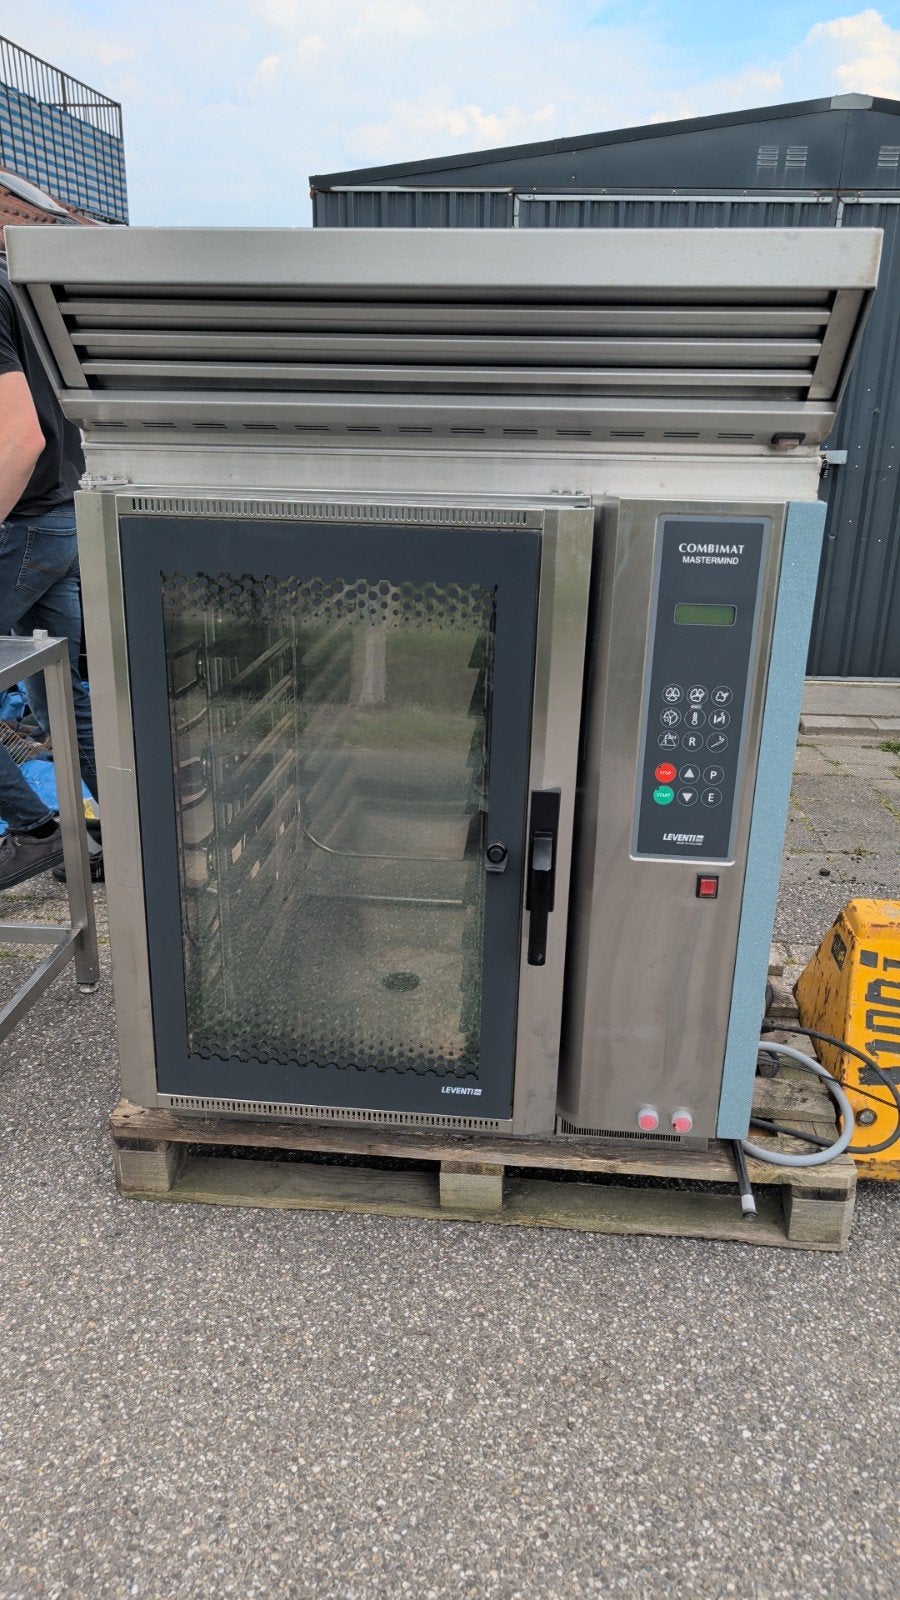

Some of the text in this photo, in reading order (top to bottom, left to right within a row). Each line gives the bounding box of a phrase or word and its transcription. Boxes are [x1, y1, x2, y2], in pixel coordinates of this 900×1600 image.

[678, 543, 745, 554] COMBIMAT
[682, 556, 739, 565] MASTERMIND
[689, 737, 696, 747] R
[710, 770, 717, 780] P
[708, 793, 714, 802] E
[662, 833, 697, 842] LEVENTI
[441, 1086, 474, 1095] LEVENTI
